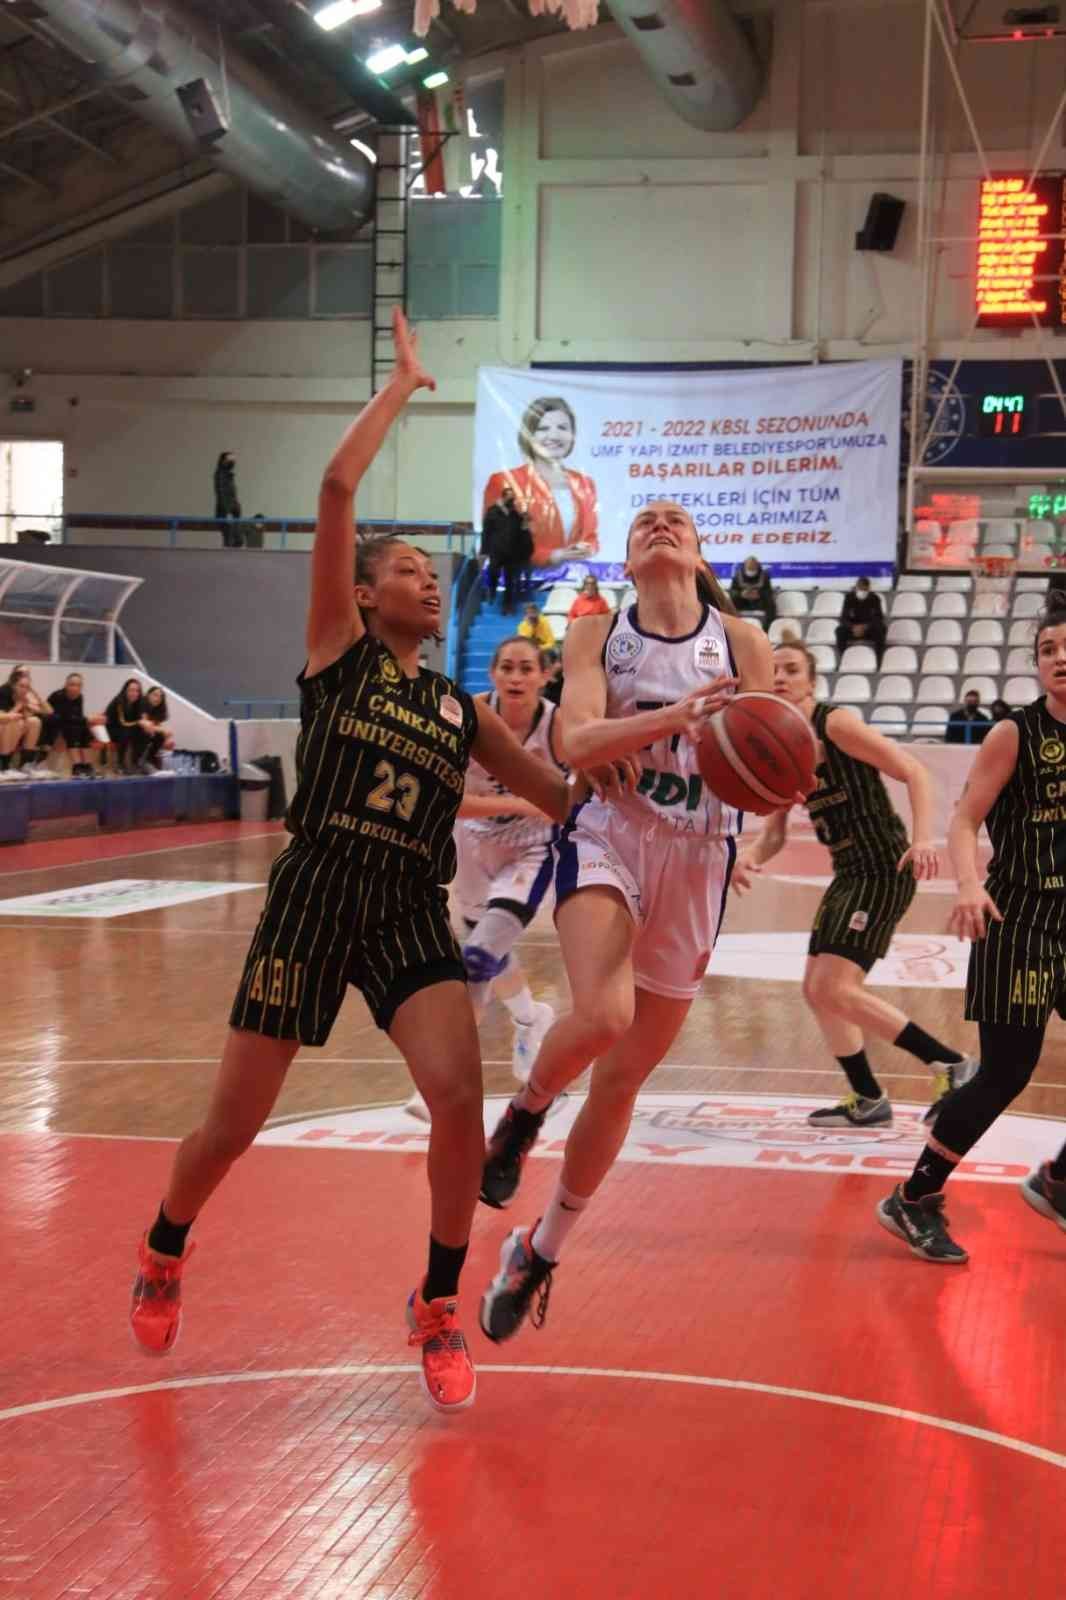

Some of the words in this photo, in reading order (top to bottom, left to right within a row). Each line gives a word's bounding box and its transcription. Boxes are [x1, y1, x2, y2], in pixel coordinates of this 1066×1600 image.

[601, 421, 643, 437] 2021
[661, 419, 705, 437] 2022
[709, 417, 751, 435] KBSL
[756, 411, 870, 434] SEZONUNDA
[628, 461, 745, 482] BAŞARILAR
[752, 453, 843, 475] DİLERİM.
[695, 509, 829, 526] SORLARIMIZA
[365, 759, 420, 821] 23
